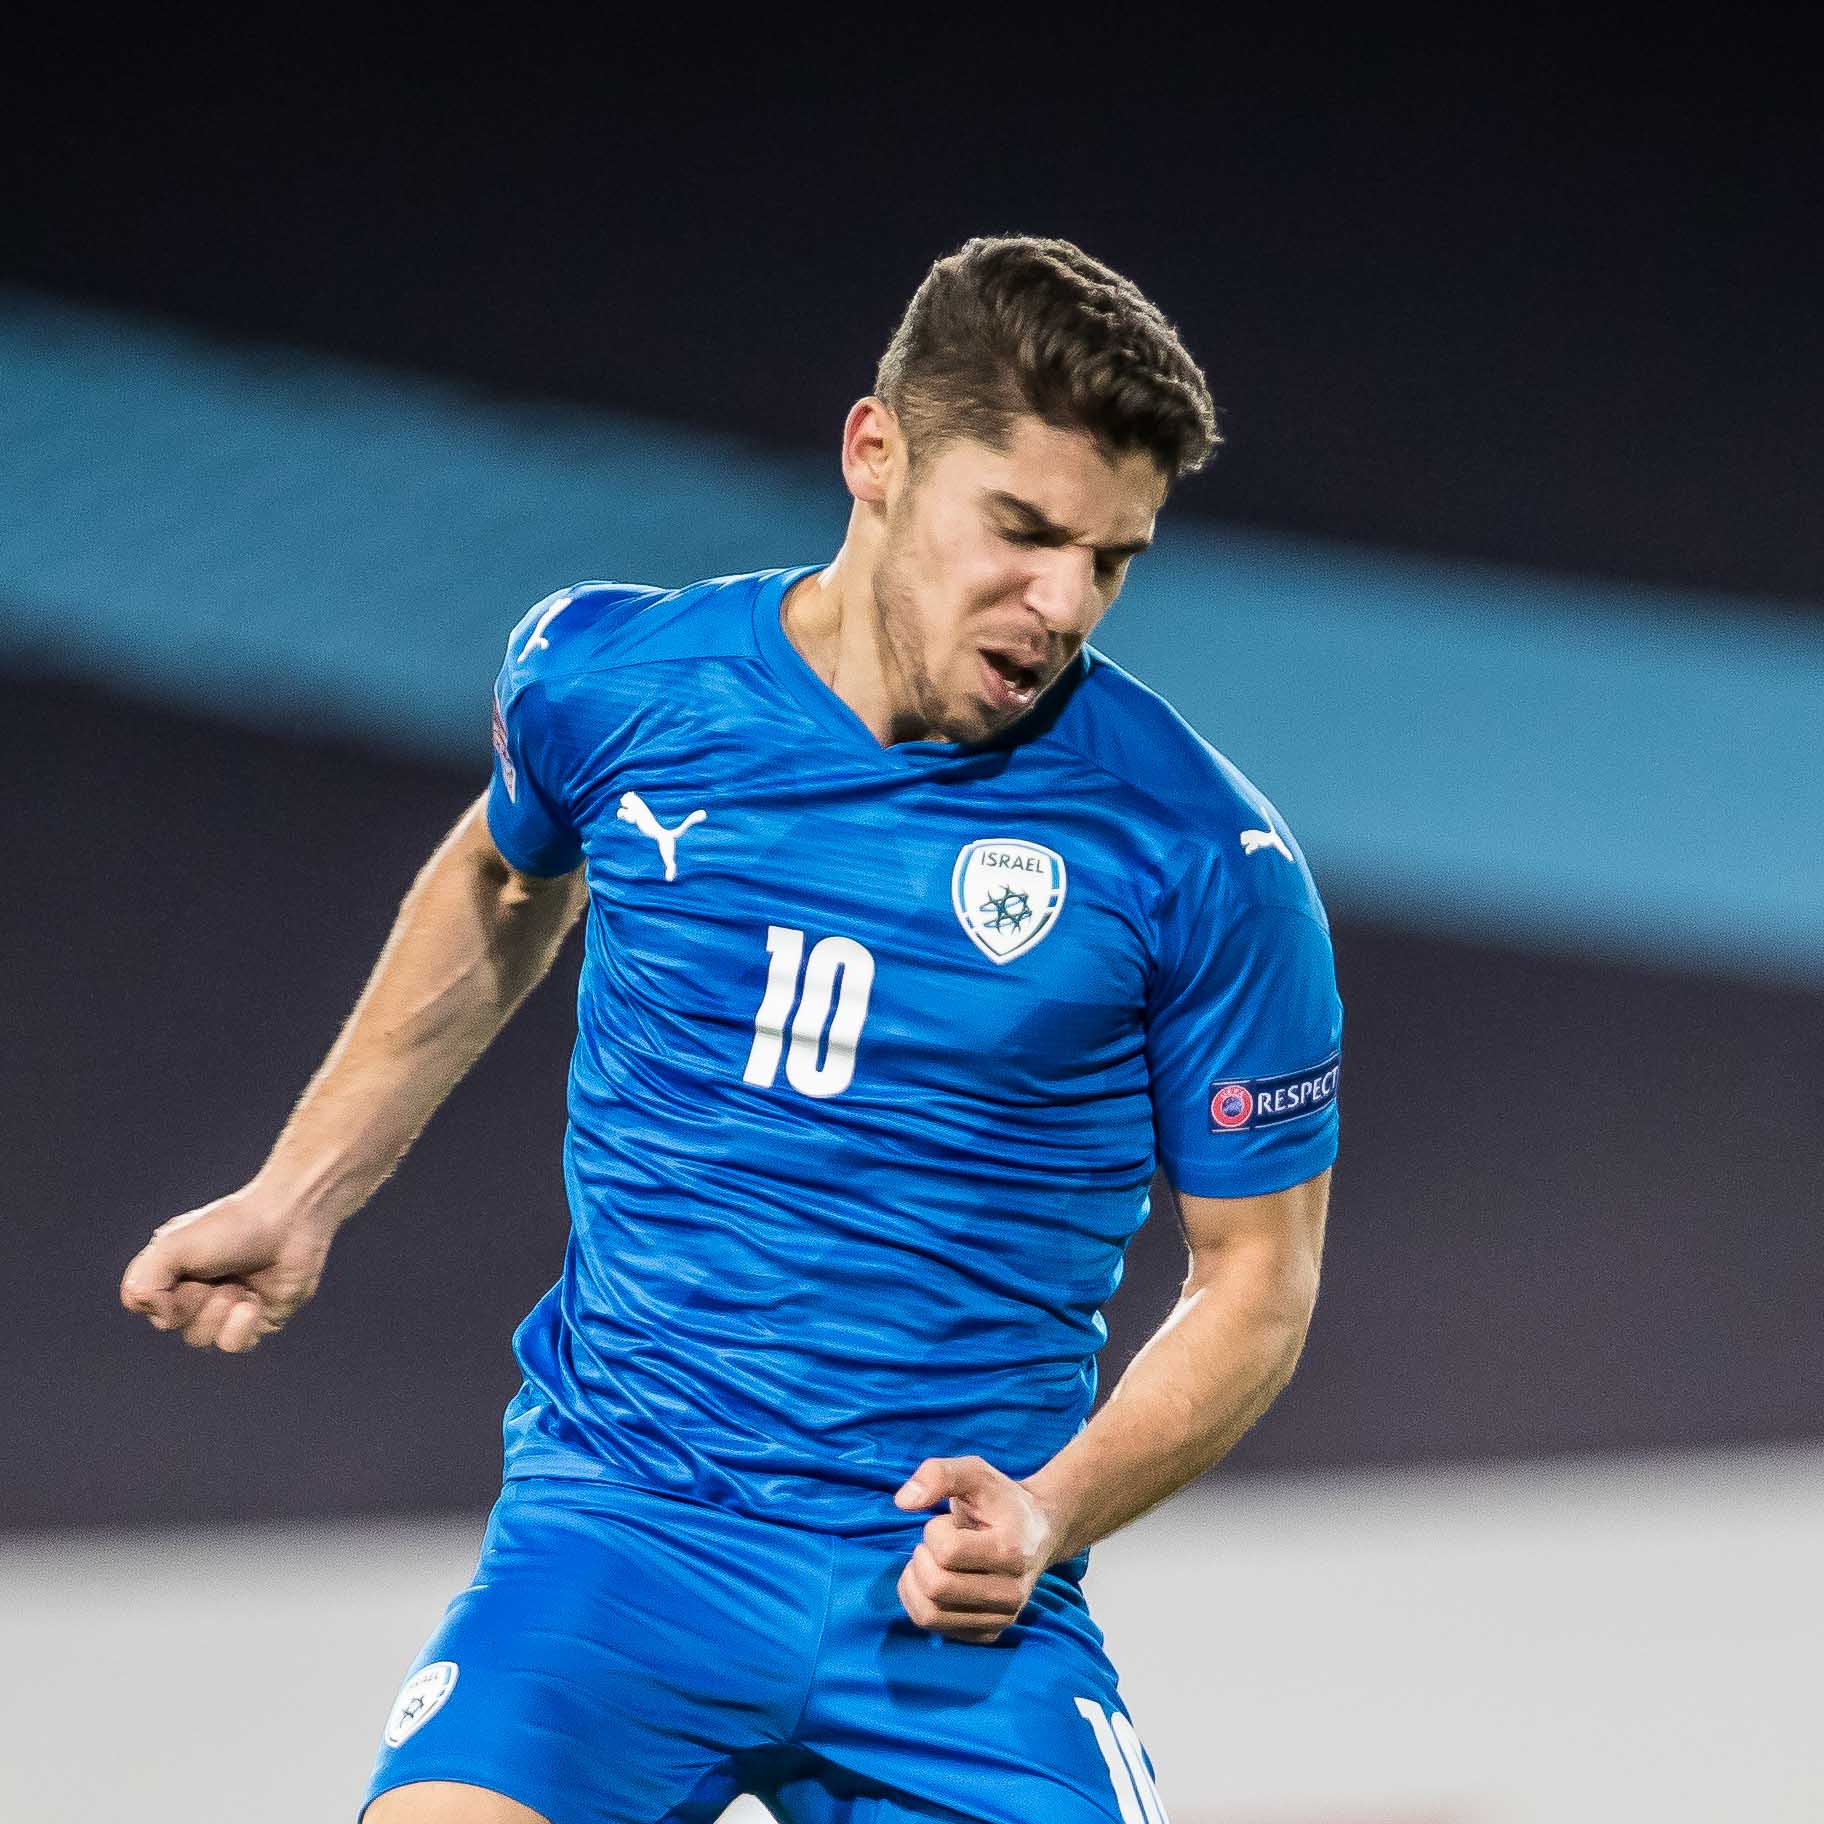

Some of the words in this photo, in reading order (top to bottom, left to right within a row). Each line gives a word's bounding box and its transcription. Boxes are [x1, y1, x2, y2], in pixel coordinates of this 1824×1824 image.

[980, 851, 1045, 874] ISRAEL
[741, 924, 876, 1098] 10
[1257, 1065, 1340, 1116] RESPECT
